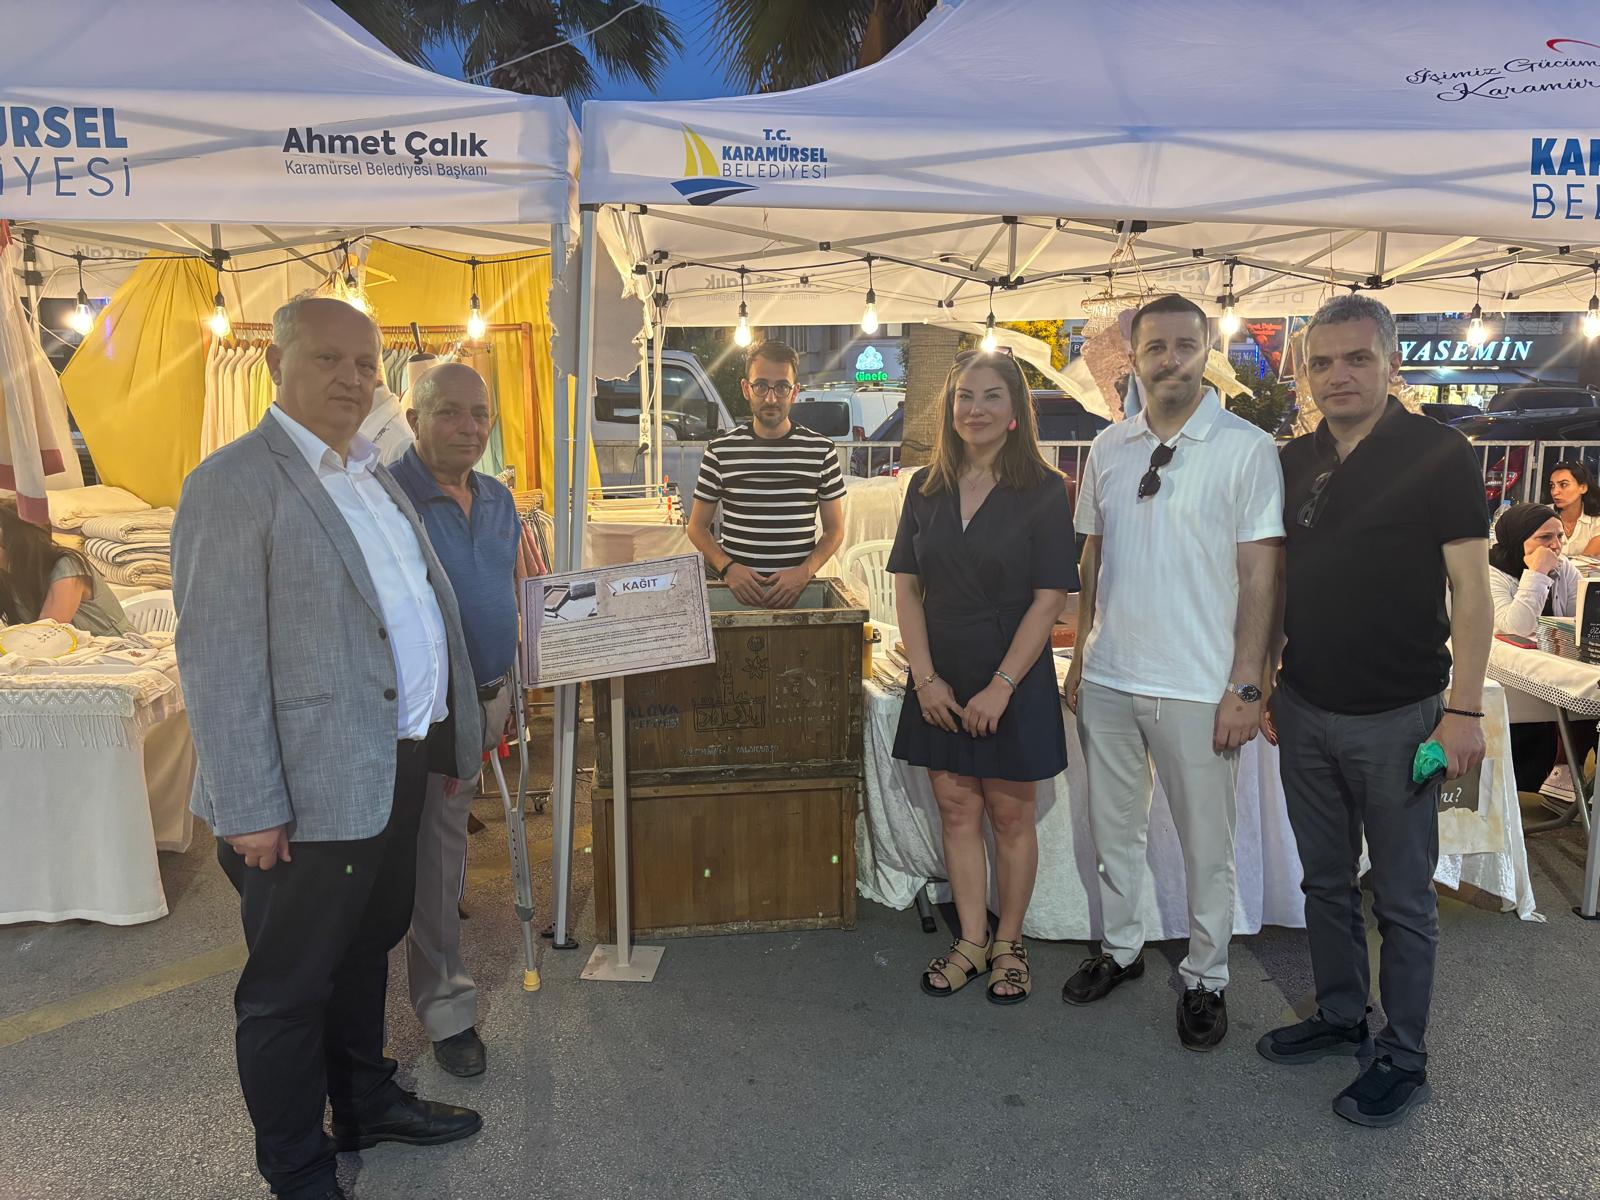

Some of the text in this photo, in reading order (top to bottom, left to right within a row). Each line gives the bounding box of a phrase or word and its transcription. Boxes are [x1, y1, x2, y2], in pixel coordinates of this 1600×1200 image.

[0, 106, 128, 148] RSEL
[763, 128, 791, 141] T.C.
[282, 127, 488, 165] Ahmet Çalık
[722, 144, 828, 163] KARAMÜRSEL
[285, 160, 488, 179] Karamürsel Belediyesi Başkanı
[723, 163, 827, 179] BELEDİYESİ
[1399, 336, 1534, 361] YASEMİN
[622, 578, 658, 591] KAĞIT
